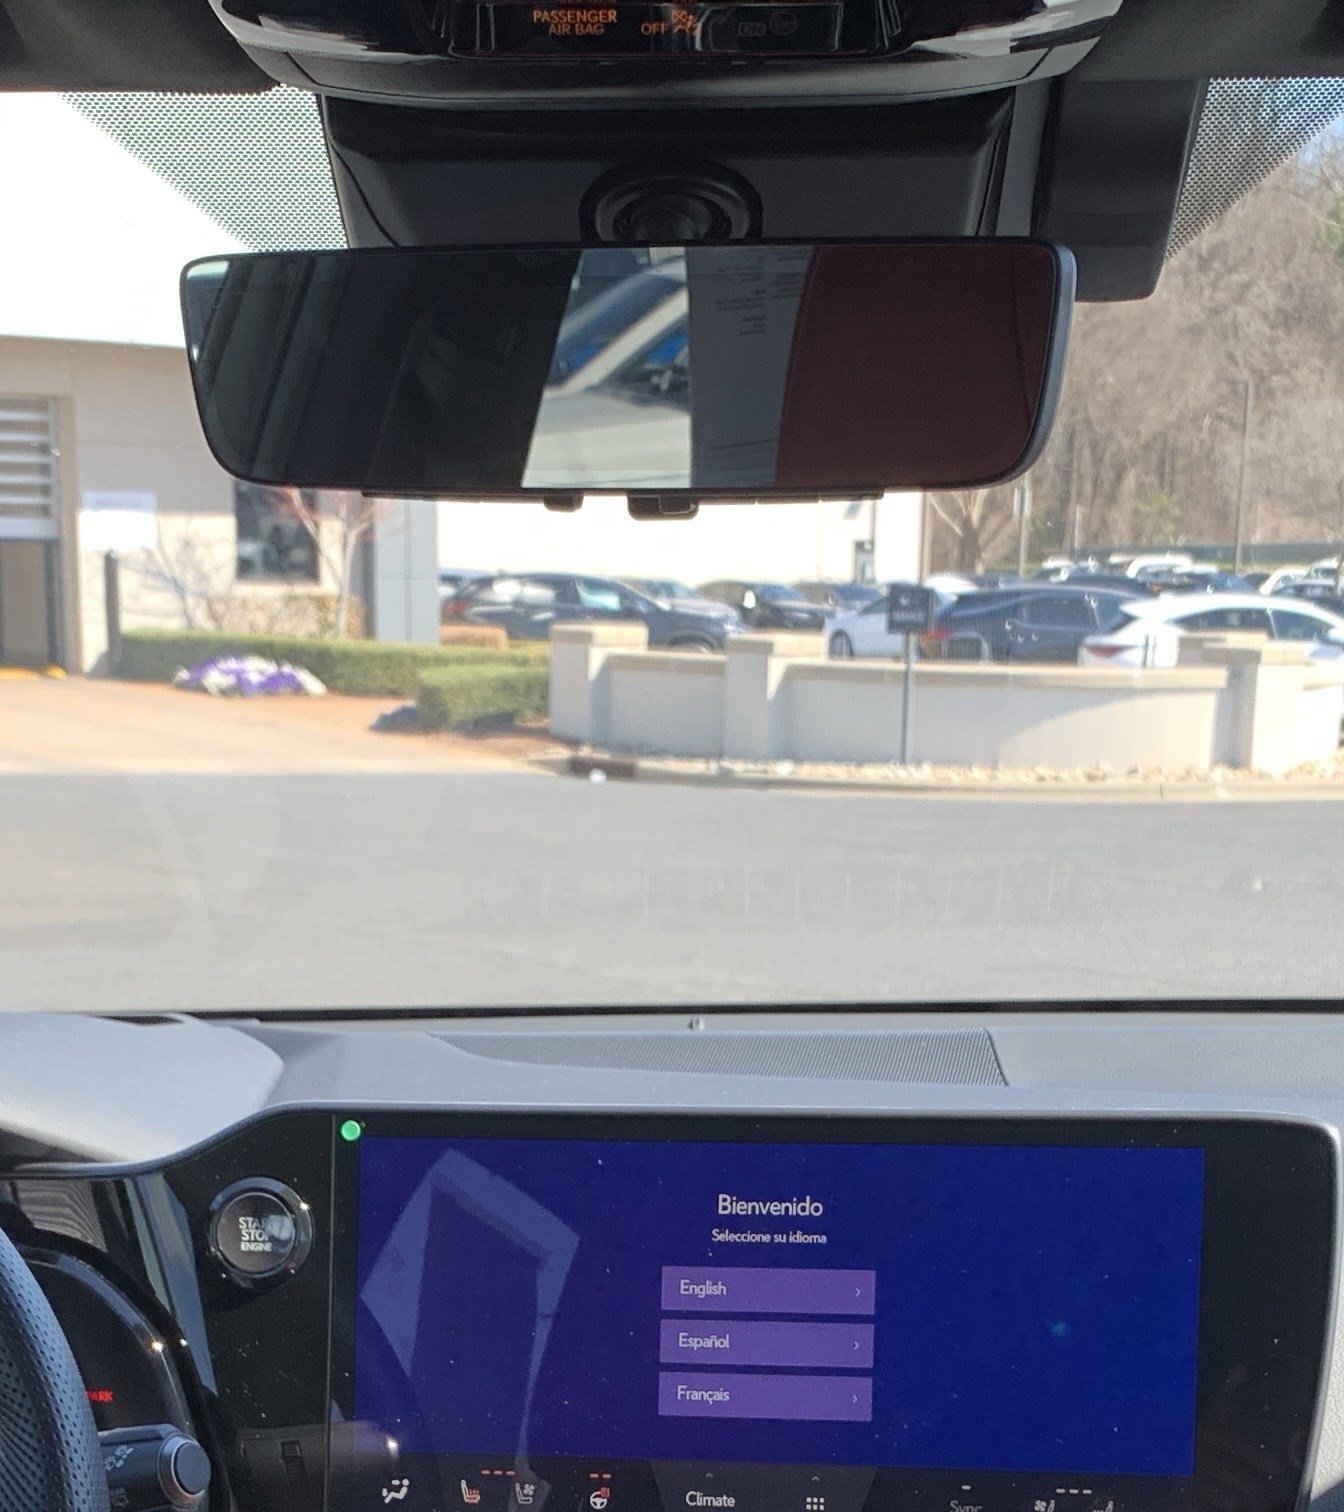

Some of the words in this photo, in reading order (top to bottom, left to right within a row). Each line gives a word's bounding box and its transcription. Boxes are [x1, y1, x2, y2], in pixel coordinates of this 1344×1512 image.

[533, 10, 617, 23] PASSENGER
[548, 24, 573, 36] AIR
[574, 24, 605, 36] BAG
[717, 1193, 823, 1216] Bienvenido
[711, 1228, 771, 1243] Seleccione
[773, 1233, 787, 1243] su
[789, 1230, 827, 1244] idioma
[680, 1279, 727, 1298] English
[678, 1332, 730, 1351] Español
[677, 1385, 730, 1405] Français
[685, 1490, 736, 1507] Climate
